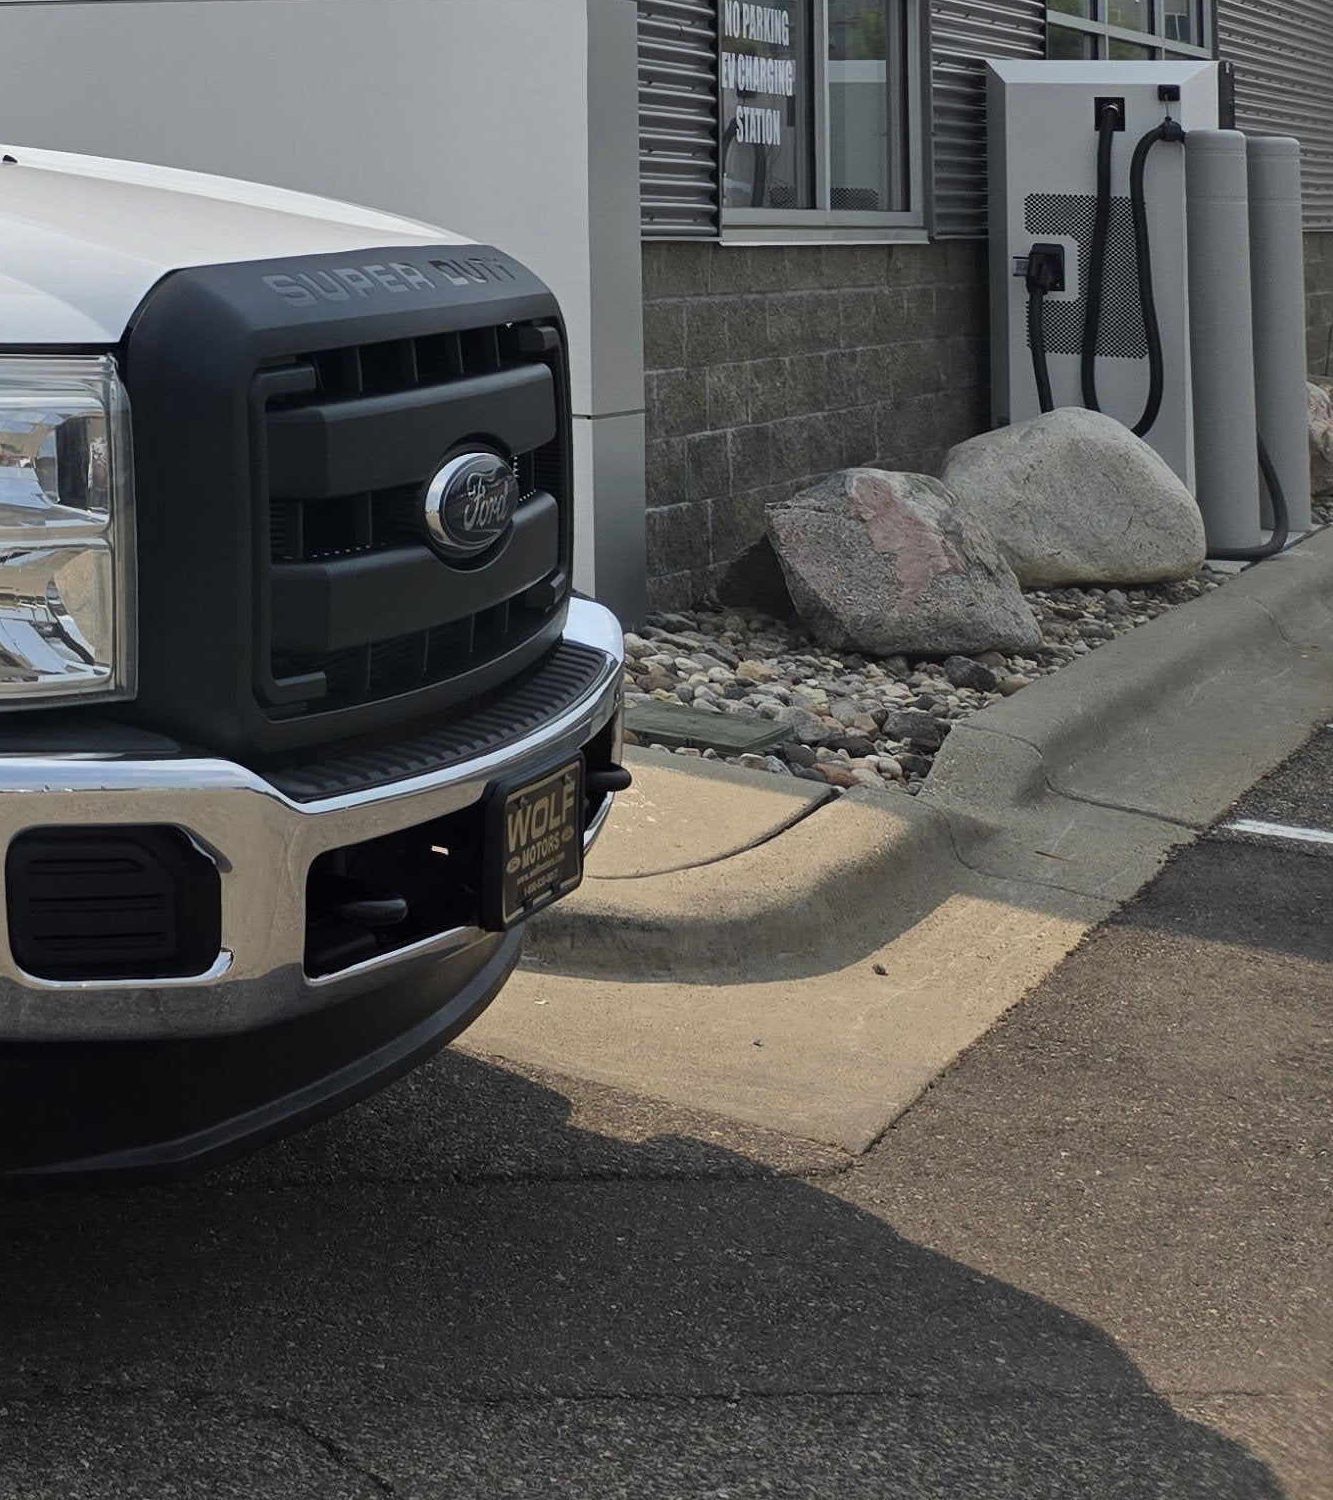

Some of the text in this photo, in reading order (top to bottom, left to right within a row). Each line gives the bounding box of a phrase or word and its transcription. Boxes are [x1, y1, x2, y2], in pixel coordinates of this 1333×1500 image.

[724, 0, 790, 46] NO PARKING
[721, 51, 793, 97] EV CHARGING
[736, 105, 781, 145] STATION
[261, 257, 516, 307] SUPER DUTY
[464, 471, 511, 532] Ford
[507, 780, 575, 852] WOLF
[522, 831, 560, 870] MOTORS
